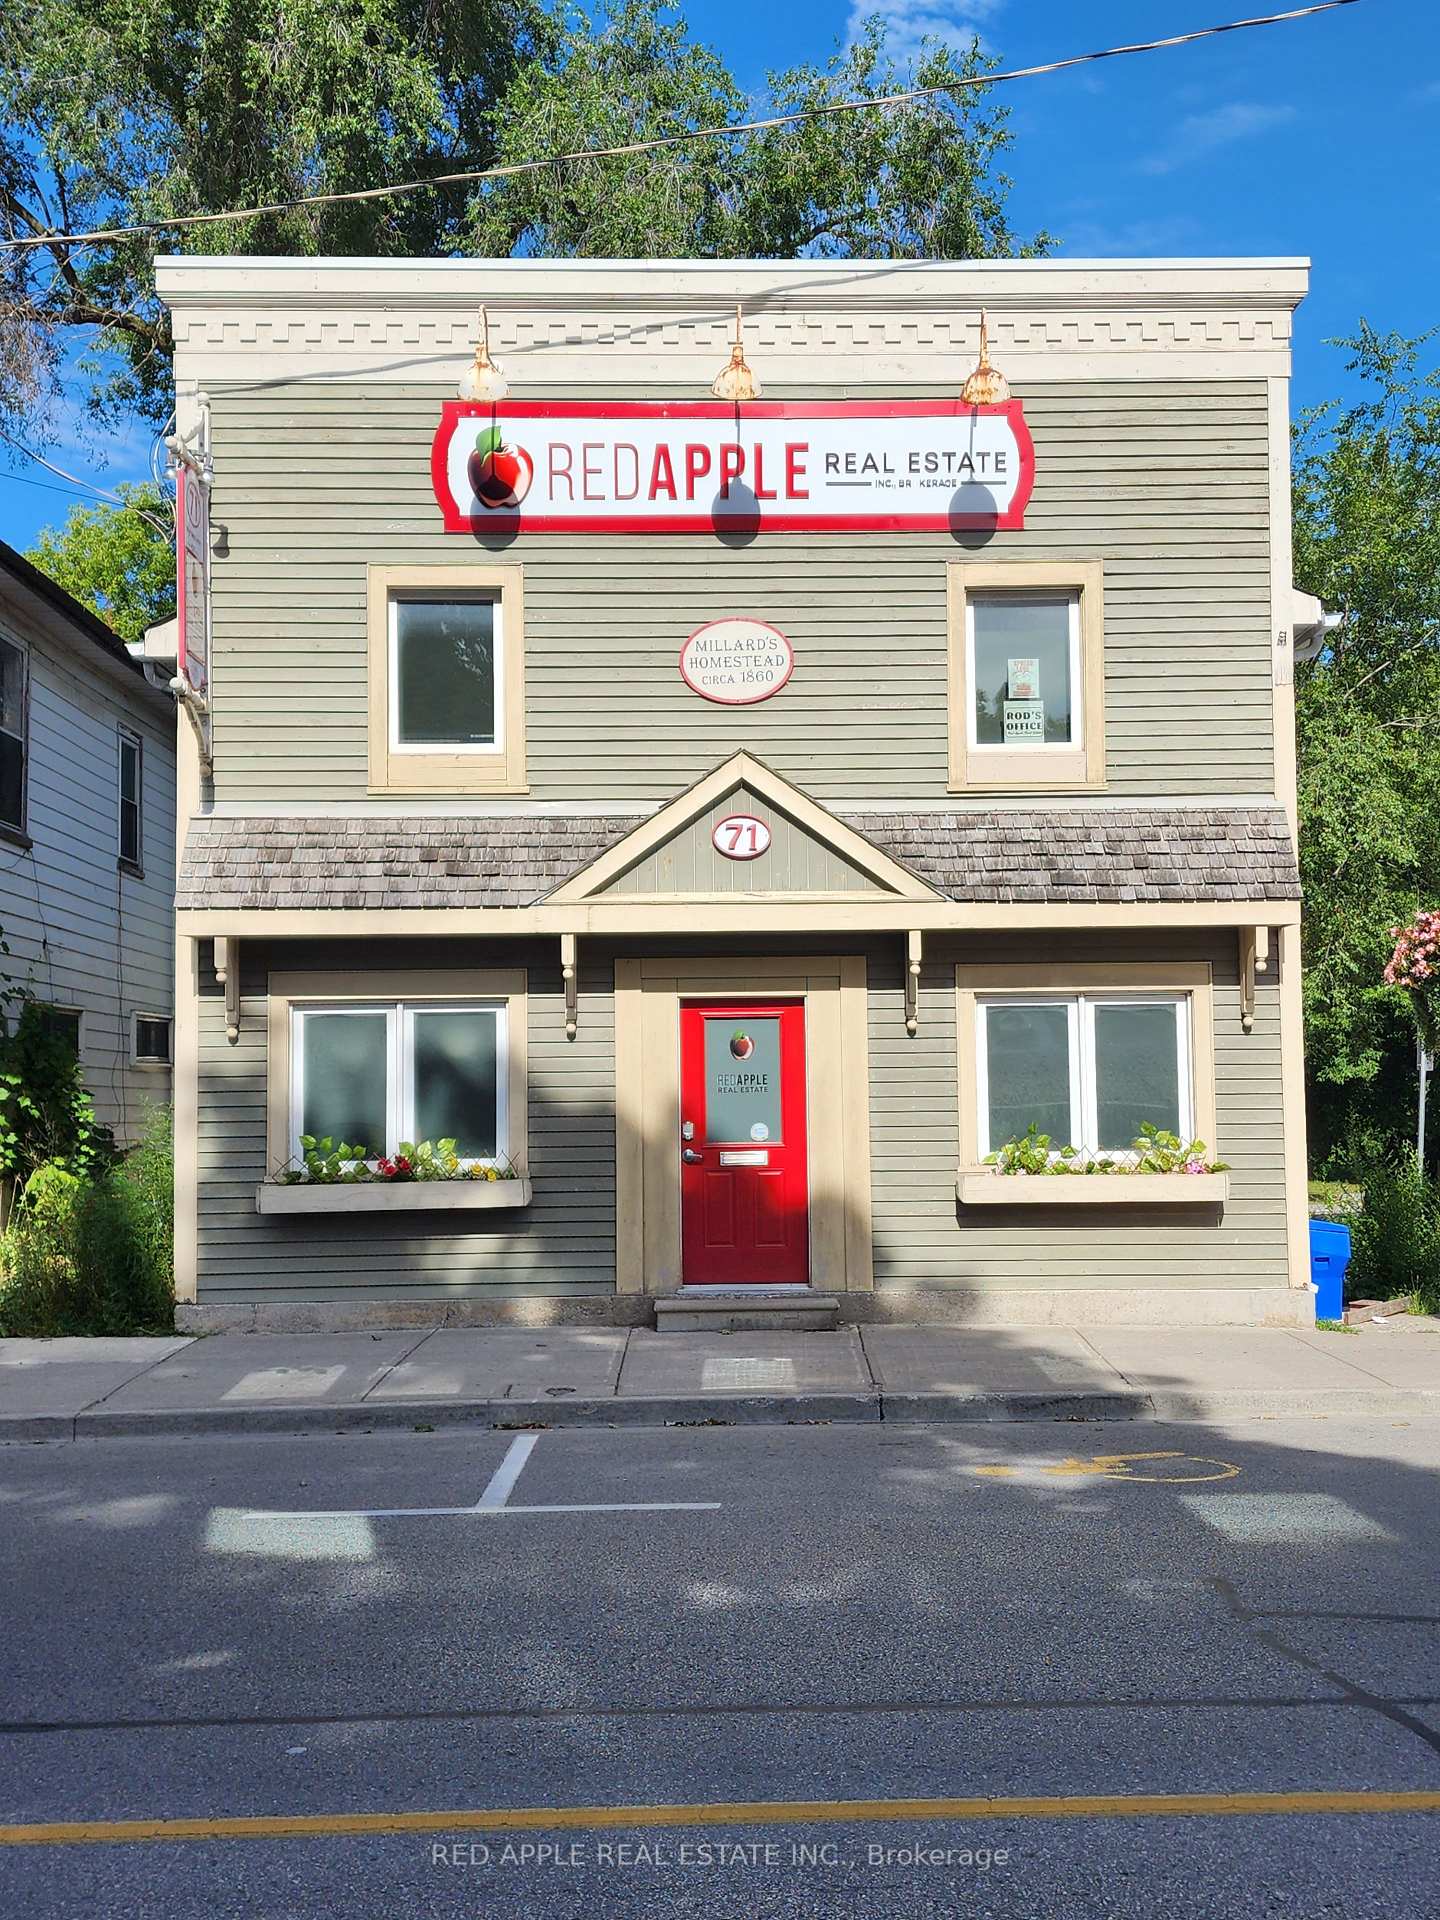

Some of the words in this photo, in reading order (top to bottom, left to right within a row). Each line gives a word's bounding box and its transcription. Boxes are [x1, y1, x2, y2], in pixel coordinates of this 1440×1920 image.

[825, 452, 895, 474] REAL
[908, 451, 1007, 474] ESTATE
[898, 478, 957, 488] BRKERAGE
[695, 636, 778, 652] MILLARD'S
[689, 654, 785, 669] HOMESTEAD
[701, 674, 736, 686] CIRCA
[741, 670, 774, 683] 1860
[1006, 711, 1042, 720] ROD'S
[1006, 722, 1043, 731] OFFICE
[725, 823, 757, 851] 71
[717, 1086, 738, 1094] REAL
